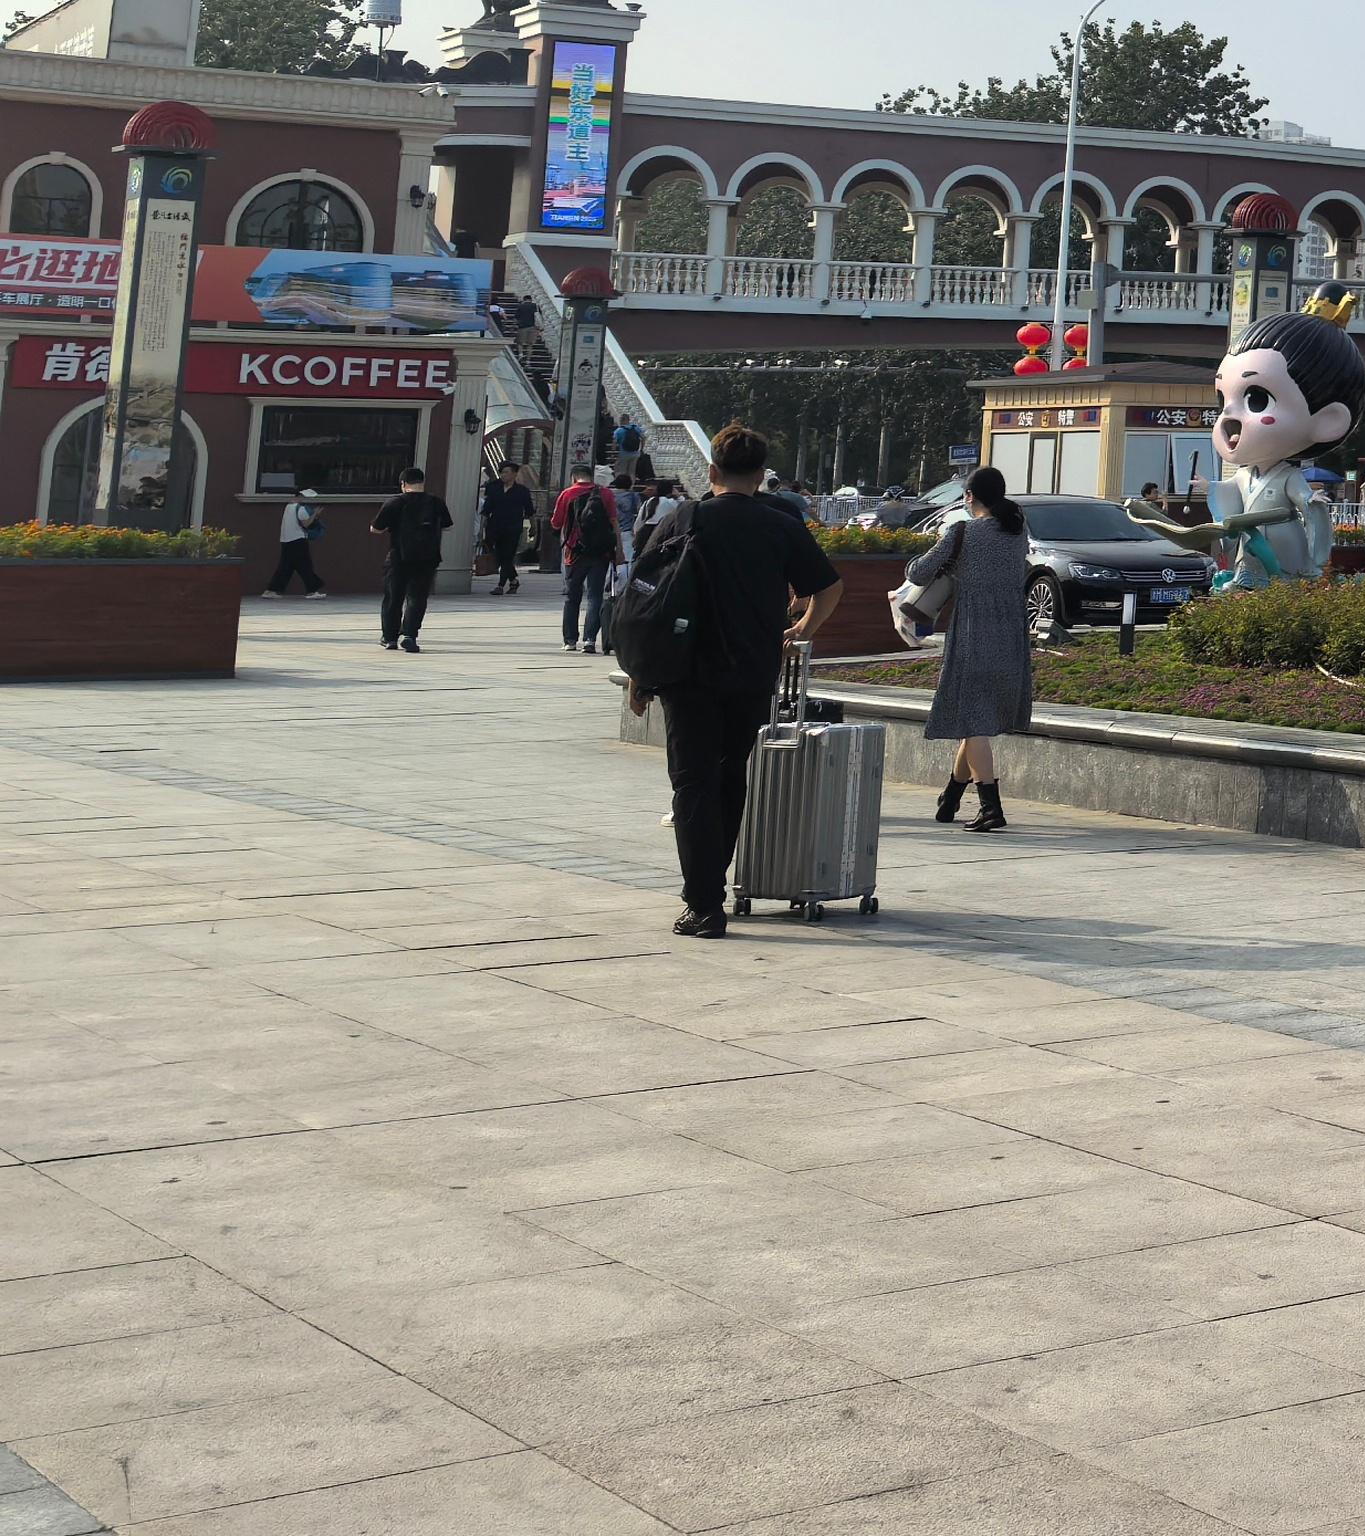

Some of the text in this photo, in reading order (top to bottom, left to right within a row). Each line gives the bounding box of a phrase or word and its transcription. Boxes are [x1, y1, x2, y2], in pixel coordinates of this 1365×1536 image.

[566, 63, 595, 161] 当好东道主
[239, 353, 450, 388] KCOFFEE
[1157, 409, 1186, 425] 公安
